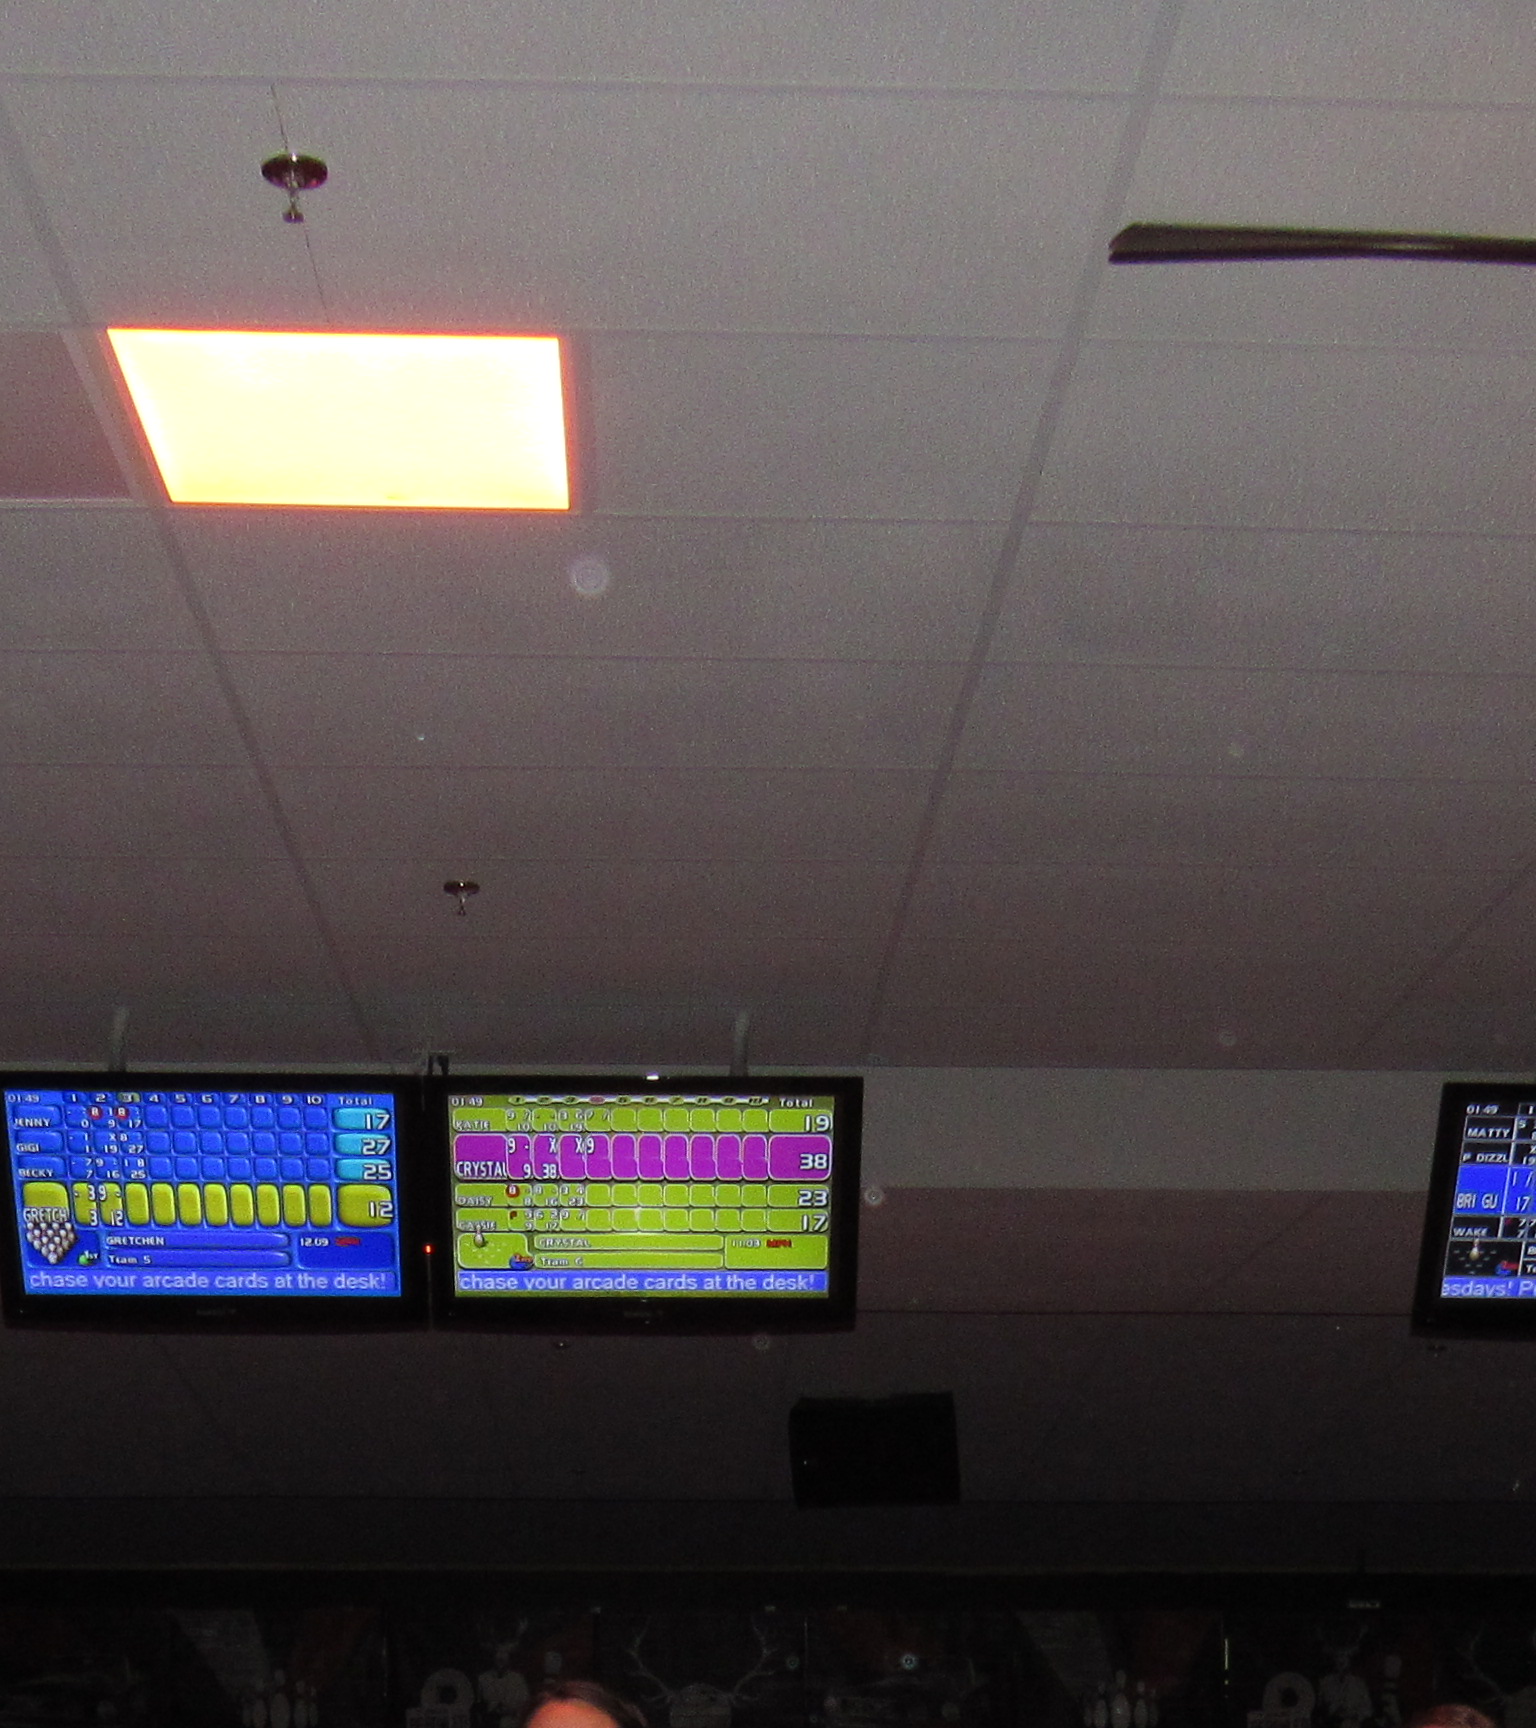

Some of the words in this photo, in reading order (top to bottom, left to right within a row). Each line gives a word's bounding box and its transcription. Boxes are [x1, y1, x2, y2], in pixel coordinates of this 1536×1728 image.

[338, 1096, 373, 1105] Total
[779, 1098, 813, 1108] Total
[364, 1113, 391, 1130] 17
[805, 1115, 830, 1132] 19
[1467, 1128, 1510, 1138] MATTY
[362, 1138, 390, 1155] 27
[363, 1164, 392, 1180] 25
[542, 1163, 557, 1179] 38
[799, 1153, 827, 1170] 38
[798, 1190, 827, 1206] 23
[1456, 1193, 1476, 1208] BRI
[1515, 1196, 1530, 1212] 17
[110, 1210, 124, 1226] 12
[368, 1201, 394, 1218] 12
[802, 1214, 827, 1231] 17
[106, 1236, 164, 1246] GRETCHEN
[30, 1272, 88, 1288] chase
[94, 1275, 137, 1289] your
[143, 1272, 208, 1288] arcade
[215, 1273, 269, 1288] cards
[275, 1274, 293, 1288] at
[297, 1273, 328, 1288] the
[334, 1273, 386, 1289] desk!
[460, 1275, 518, 1290] chase
[524, 1279, 567, 1292] your
[573, 1274, 638, 1290] arcade
[644, 1274, 699, 1290] cards
[704, 1275, 721, 1290] at
[726, 1274, 757, 1290] the
[762, 1274, 814, 1290] desk!
